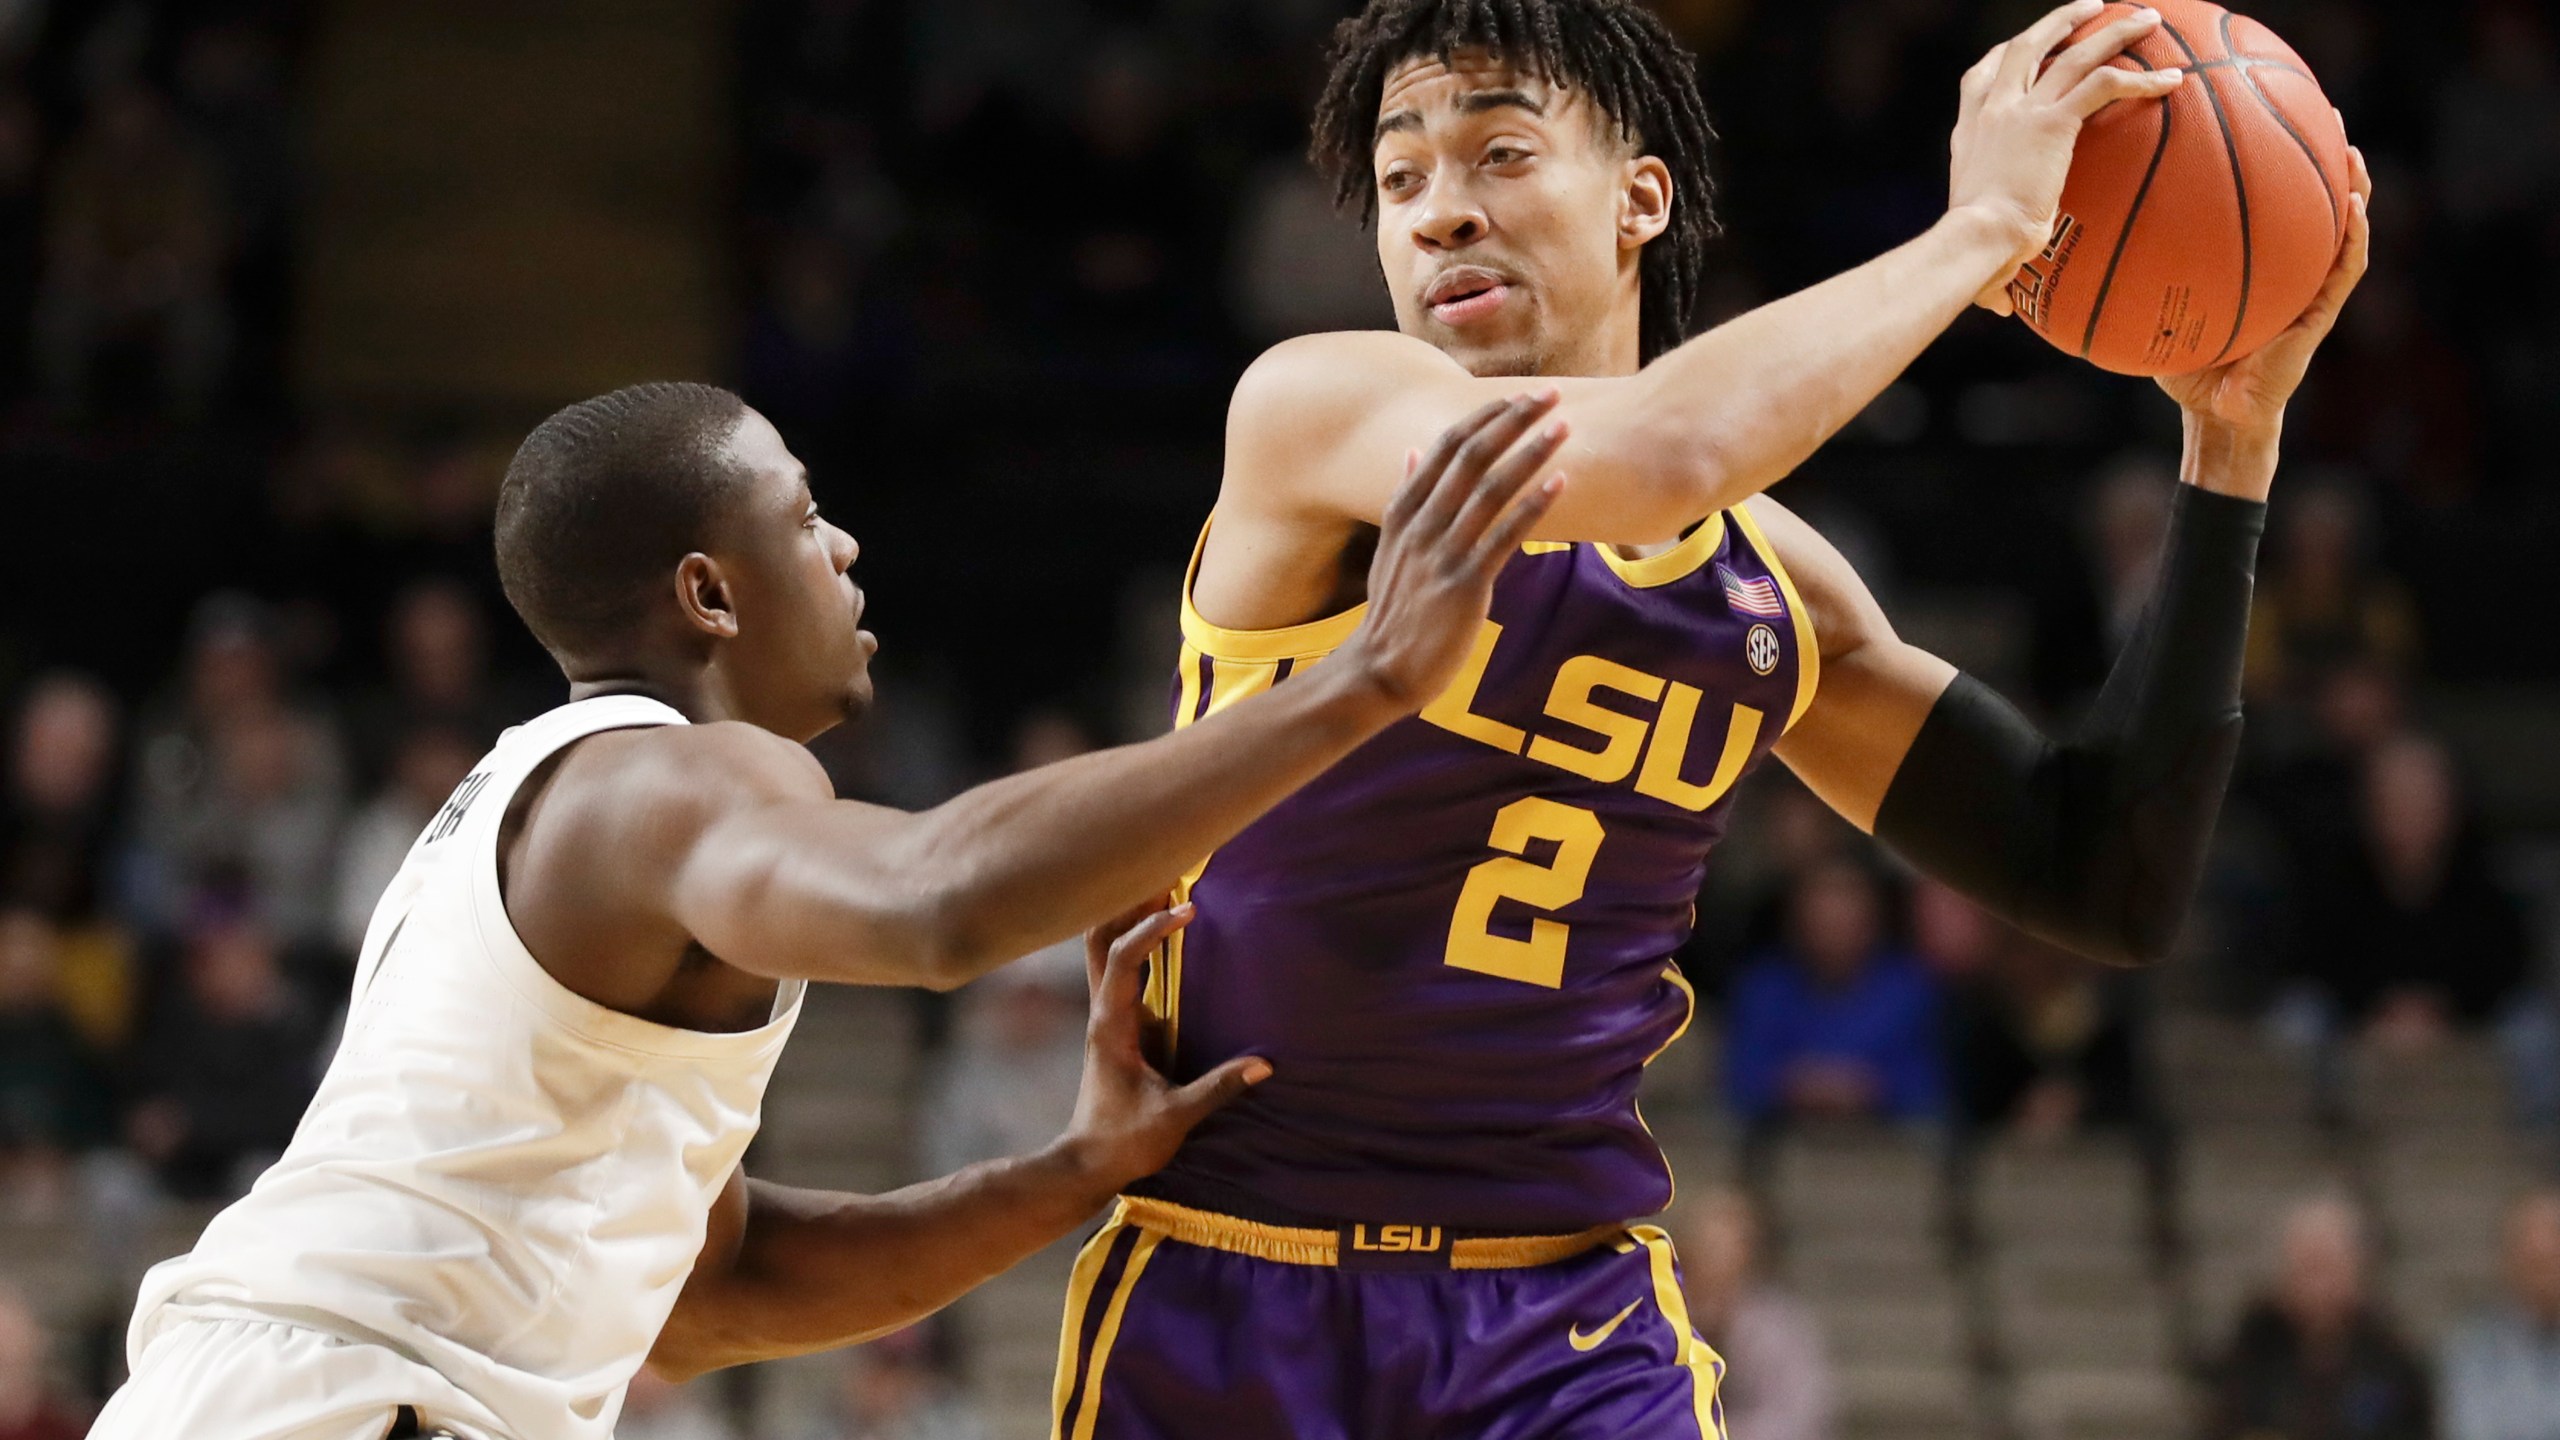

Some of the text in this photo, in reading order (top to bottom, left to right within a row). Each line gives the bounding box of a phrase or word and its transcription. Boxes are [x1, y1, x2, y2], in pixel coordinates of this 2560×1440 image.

[1750, 628, 1776, 671] SEC
[1419, 618, 1764, 812] LSU
[1444, 796, 1606, 989] 2
[1353, 1224, 1442, 1252] LSU
